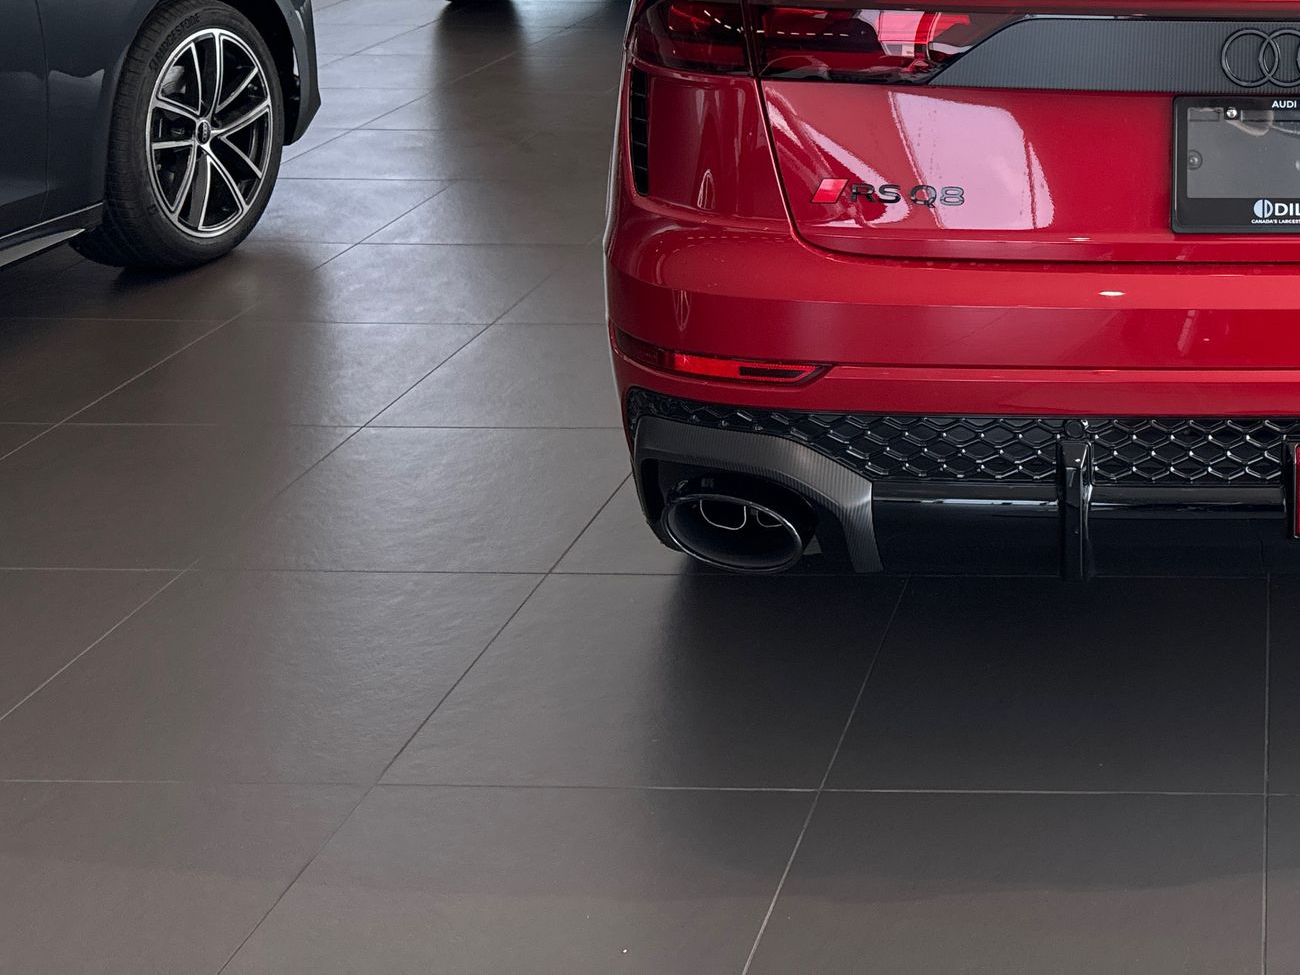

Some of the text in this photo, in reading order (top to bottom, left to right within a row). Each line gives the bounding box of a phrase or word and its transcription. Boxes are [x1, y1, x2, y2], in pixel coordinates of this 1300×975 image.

[1271, 100, 1297, 109] AUDI
[851, 183, 965, 209] RS Q8
